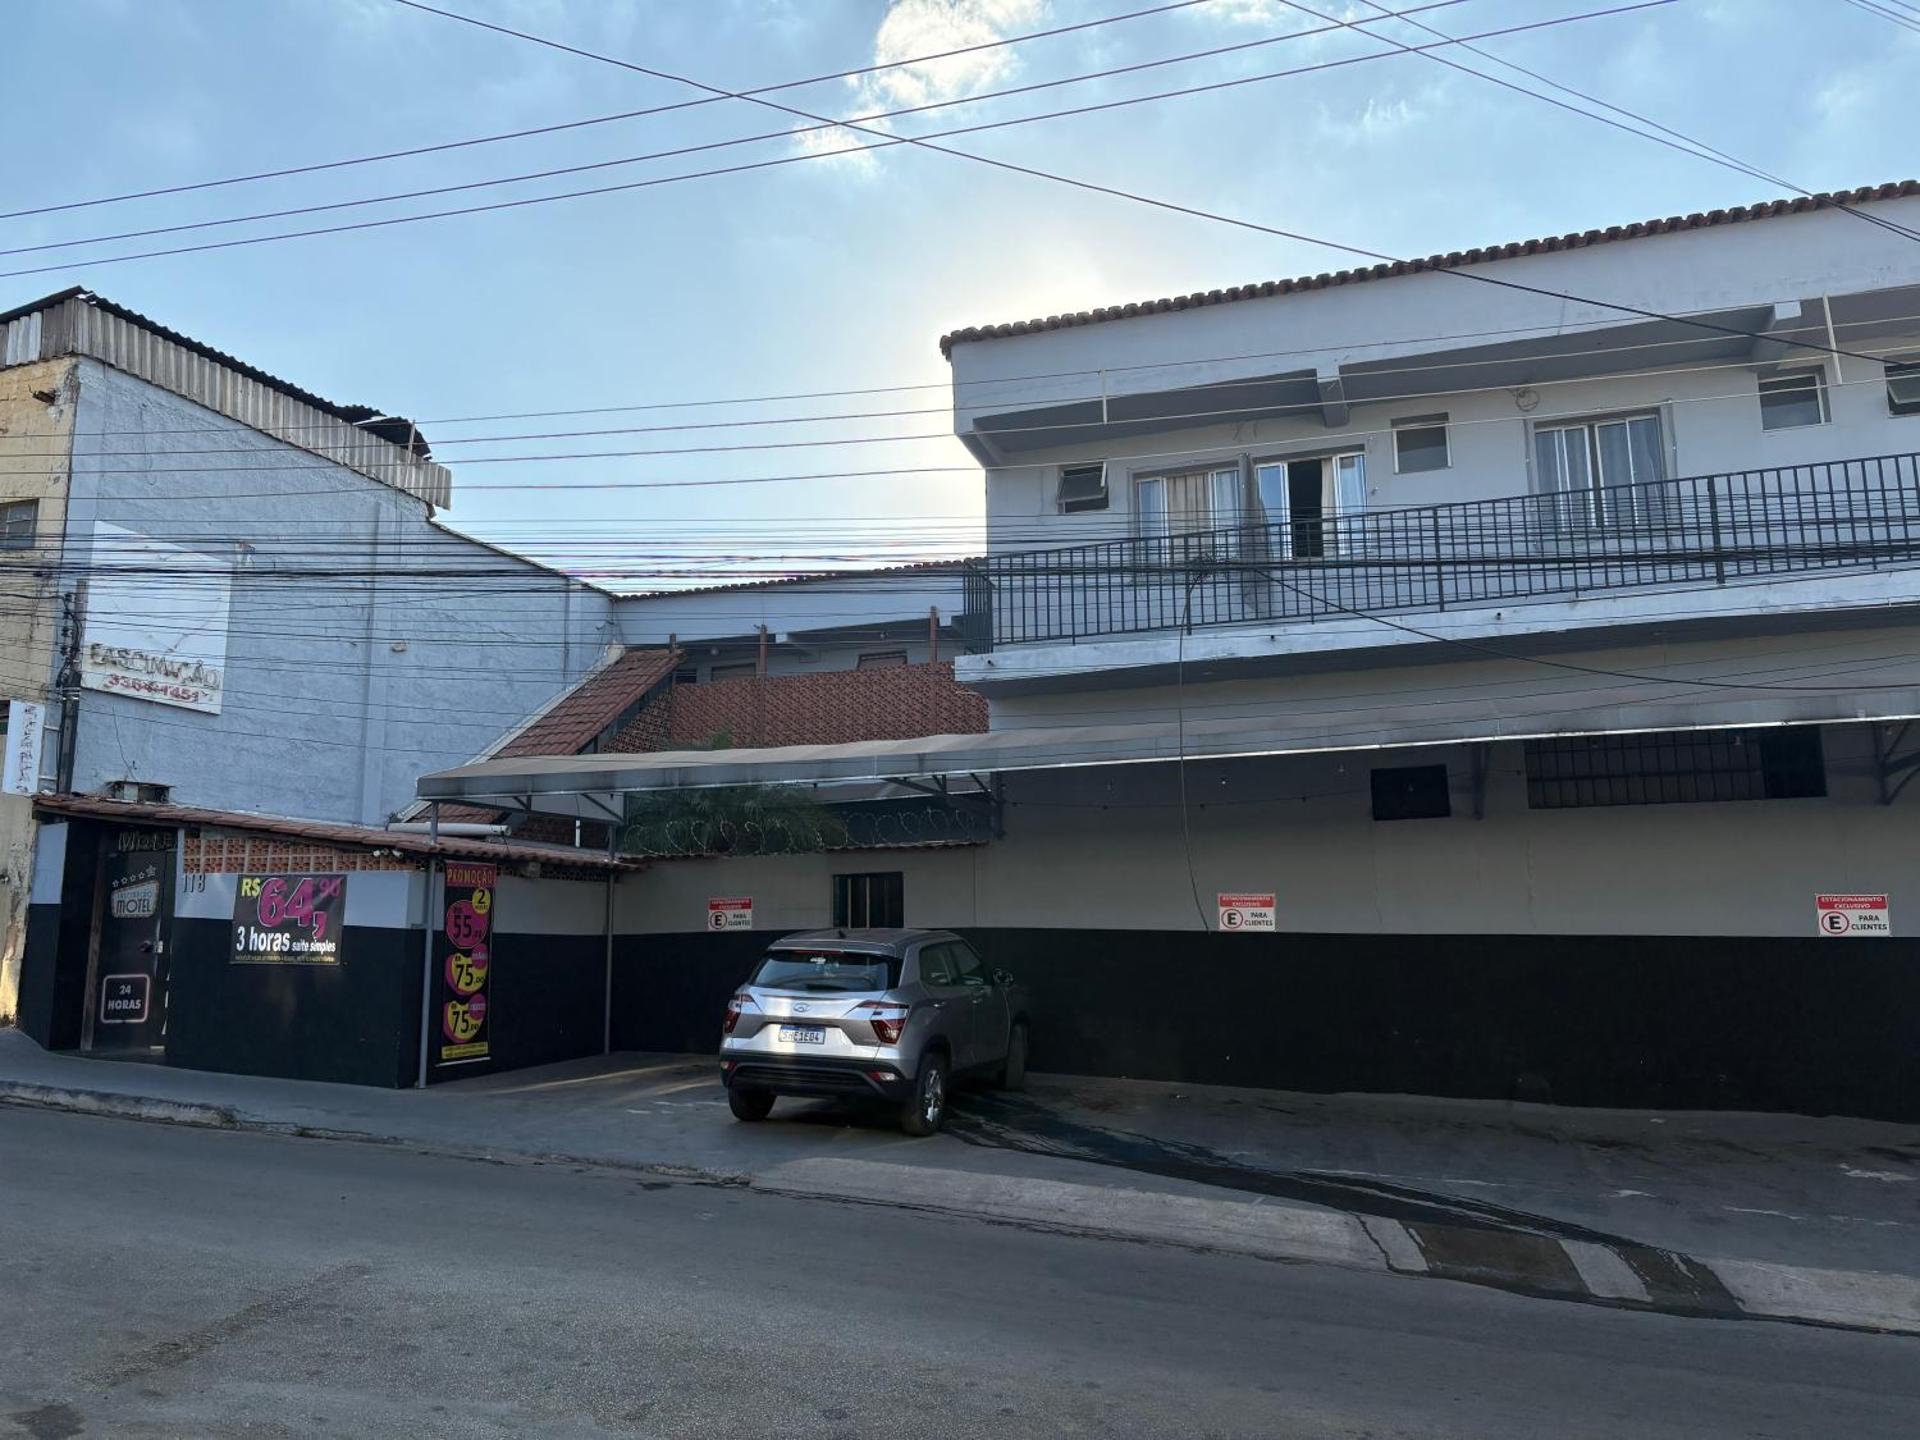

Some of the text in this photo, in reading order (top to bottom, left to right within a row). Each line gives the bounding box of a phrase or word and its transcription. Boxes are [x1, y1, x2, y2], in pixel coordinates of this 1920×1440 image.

[478, 889, 486, 905] 2
[116, 898, 152, 914] MOTEL
[714, 914, 722, 926] E
[1227, 912, 1237, 926] E
[1829, 915, 1842, 930] E
[1851, 923, 1888, 931] CLIENTES
[236, 926, 246, 951] 3
[249, 926, 291, 952] horas
[120, 985, 131, 995] 24
[108, 999, 142, 1010] HORAS
